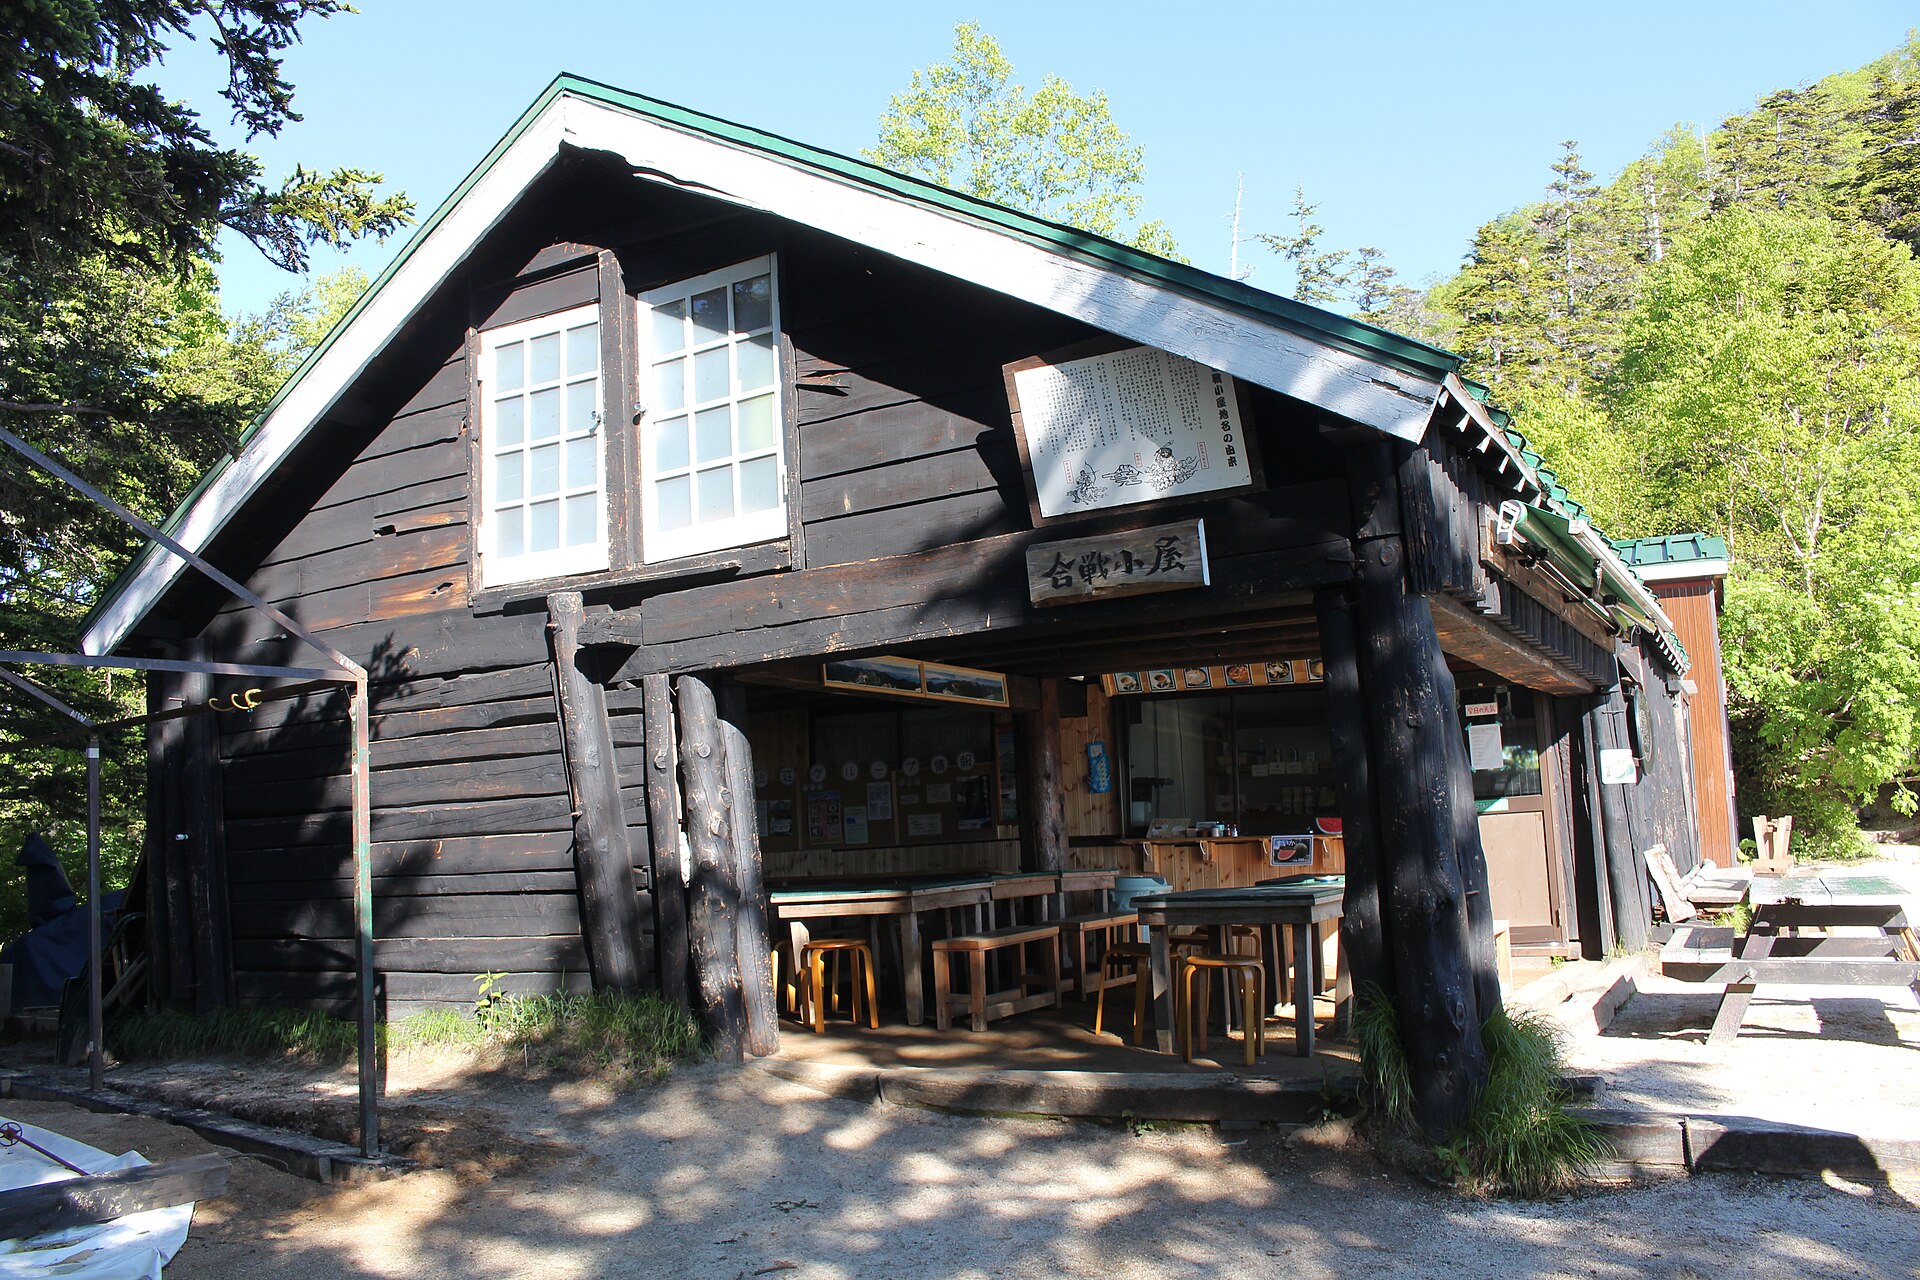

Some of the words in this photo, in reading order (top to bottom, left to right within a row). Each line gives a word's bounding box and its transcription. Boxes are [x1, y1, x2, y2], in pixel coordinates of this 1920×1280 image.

[1211, 369, 1238, 468] 戦小屋地名の由来
[1041, 536, 1186, 589] 合戦小屋
